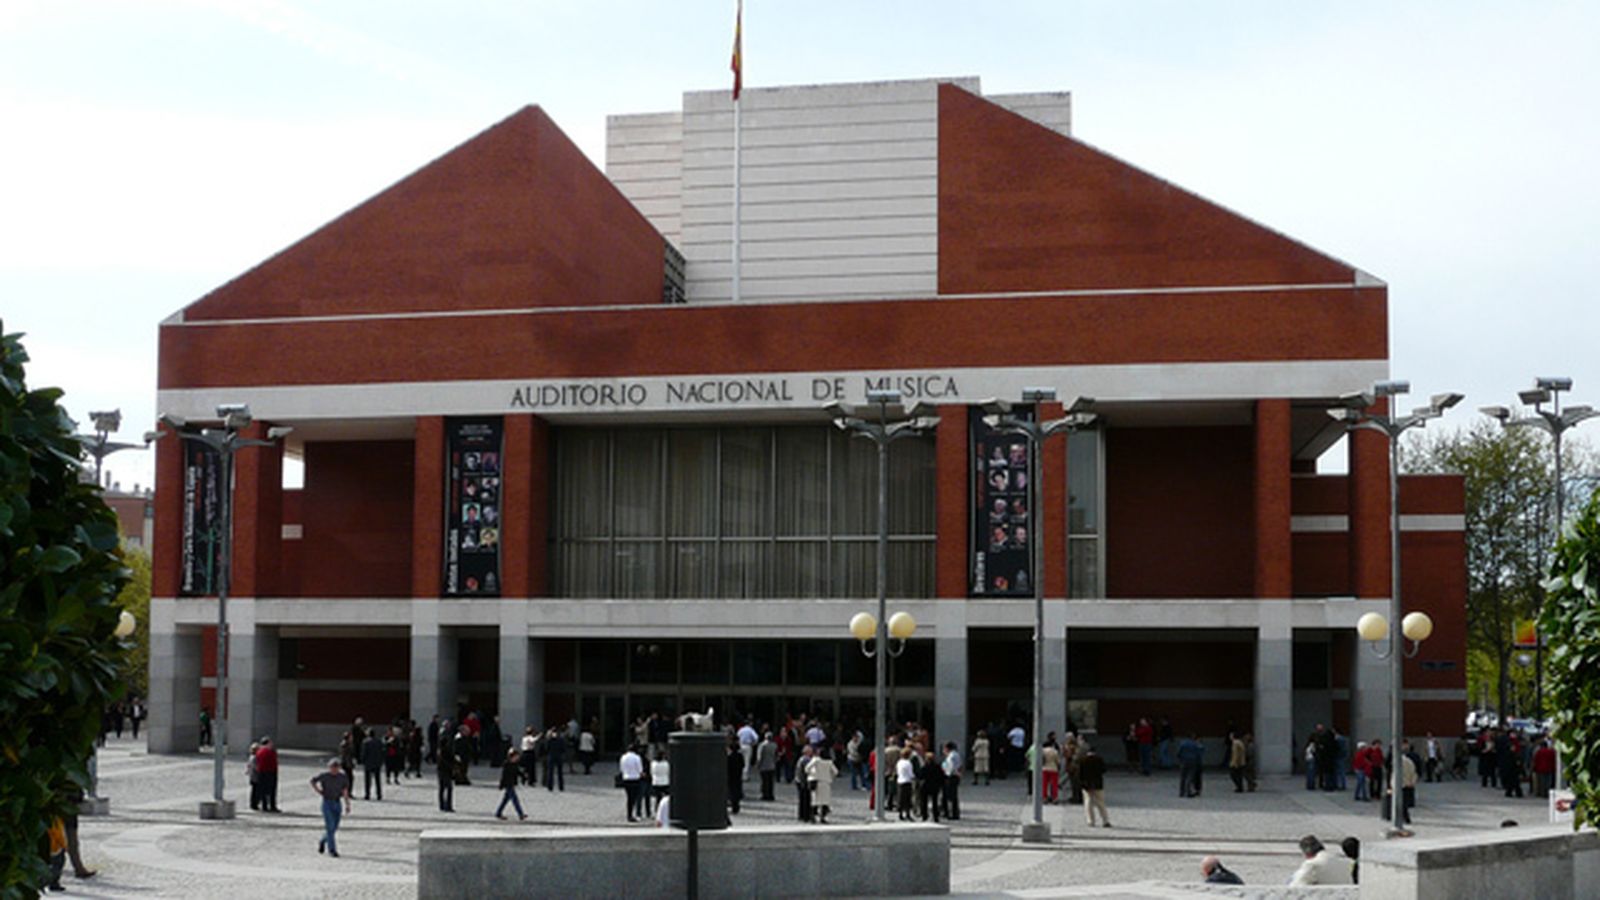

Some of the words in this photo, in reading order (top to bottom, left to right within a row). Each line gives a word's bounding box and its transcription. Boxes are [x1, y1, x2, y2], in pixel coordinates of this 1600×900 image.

[511, 384, 647, 407] AUDITORIO
[666, 380, 792, 403] NACIONAL
[812, 378, 847, 400] DE
